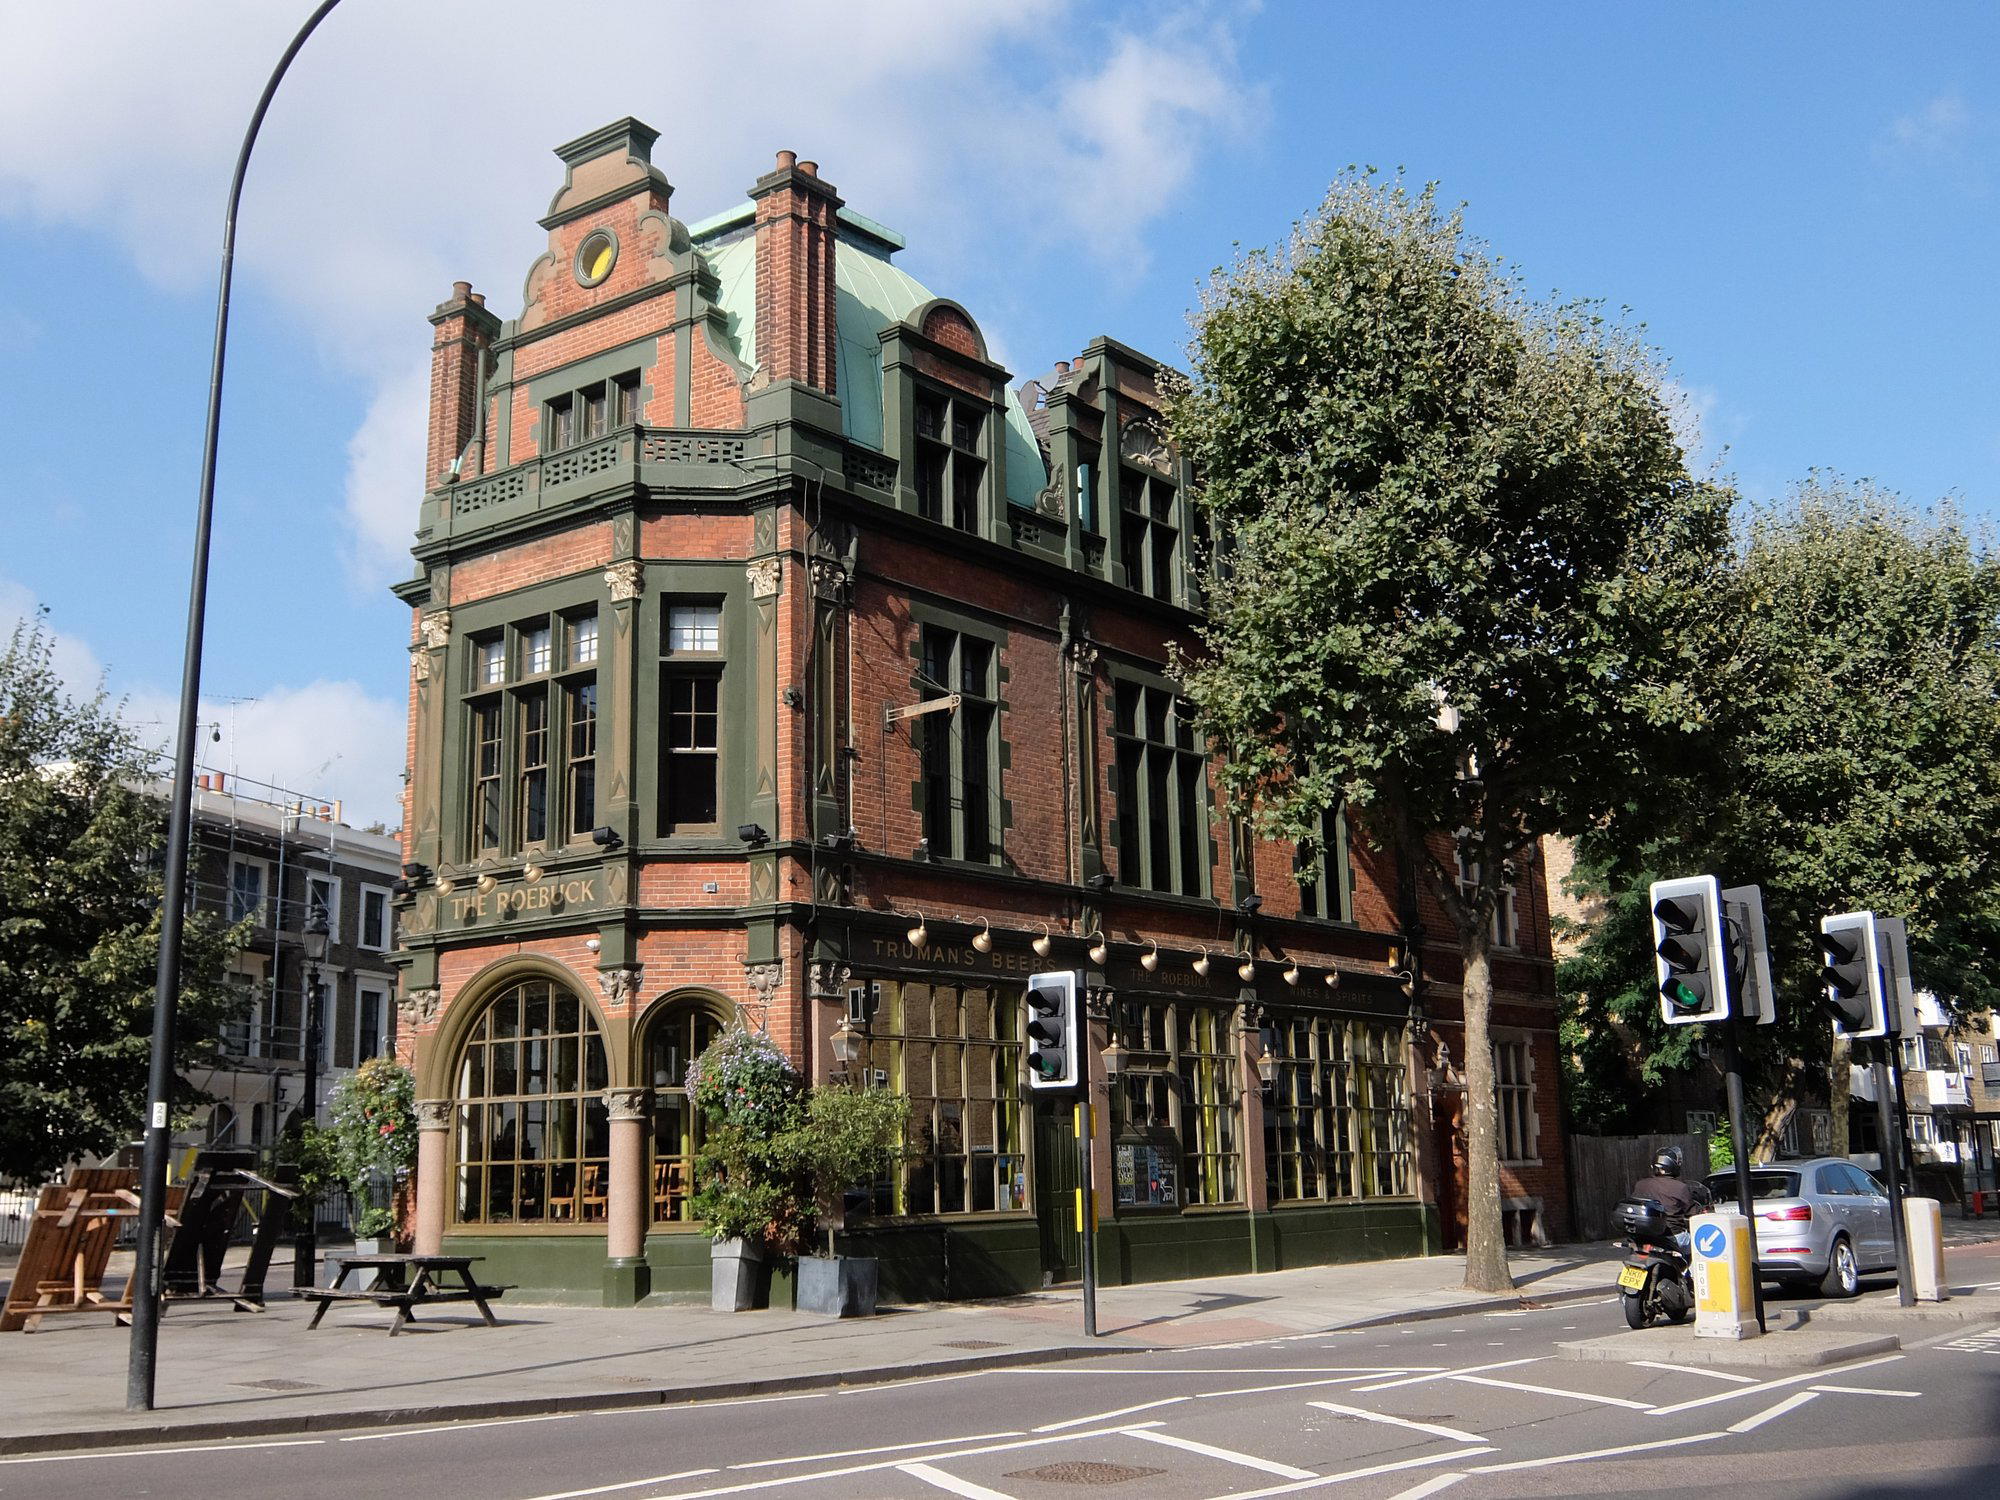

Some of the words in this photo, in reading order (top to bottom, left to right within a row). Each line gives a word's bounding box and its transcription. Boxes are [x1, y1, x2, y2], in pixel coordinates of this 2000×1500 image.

[450, 894, 487, 920] THE
[496, 879, 595, 914] ROEBUCK
[873, 939, 975, 966] TRUMAN'S
[992, 952, 1056, 972] BEERS
[1130, 967, 1151, 983] THE
[1161, 972, 1212, 988] ROEBUCK
[1336, 991, 1374, 1004] SPIRITS
[1623, 1275, 1640, 1287] EPX
